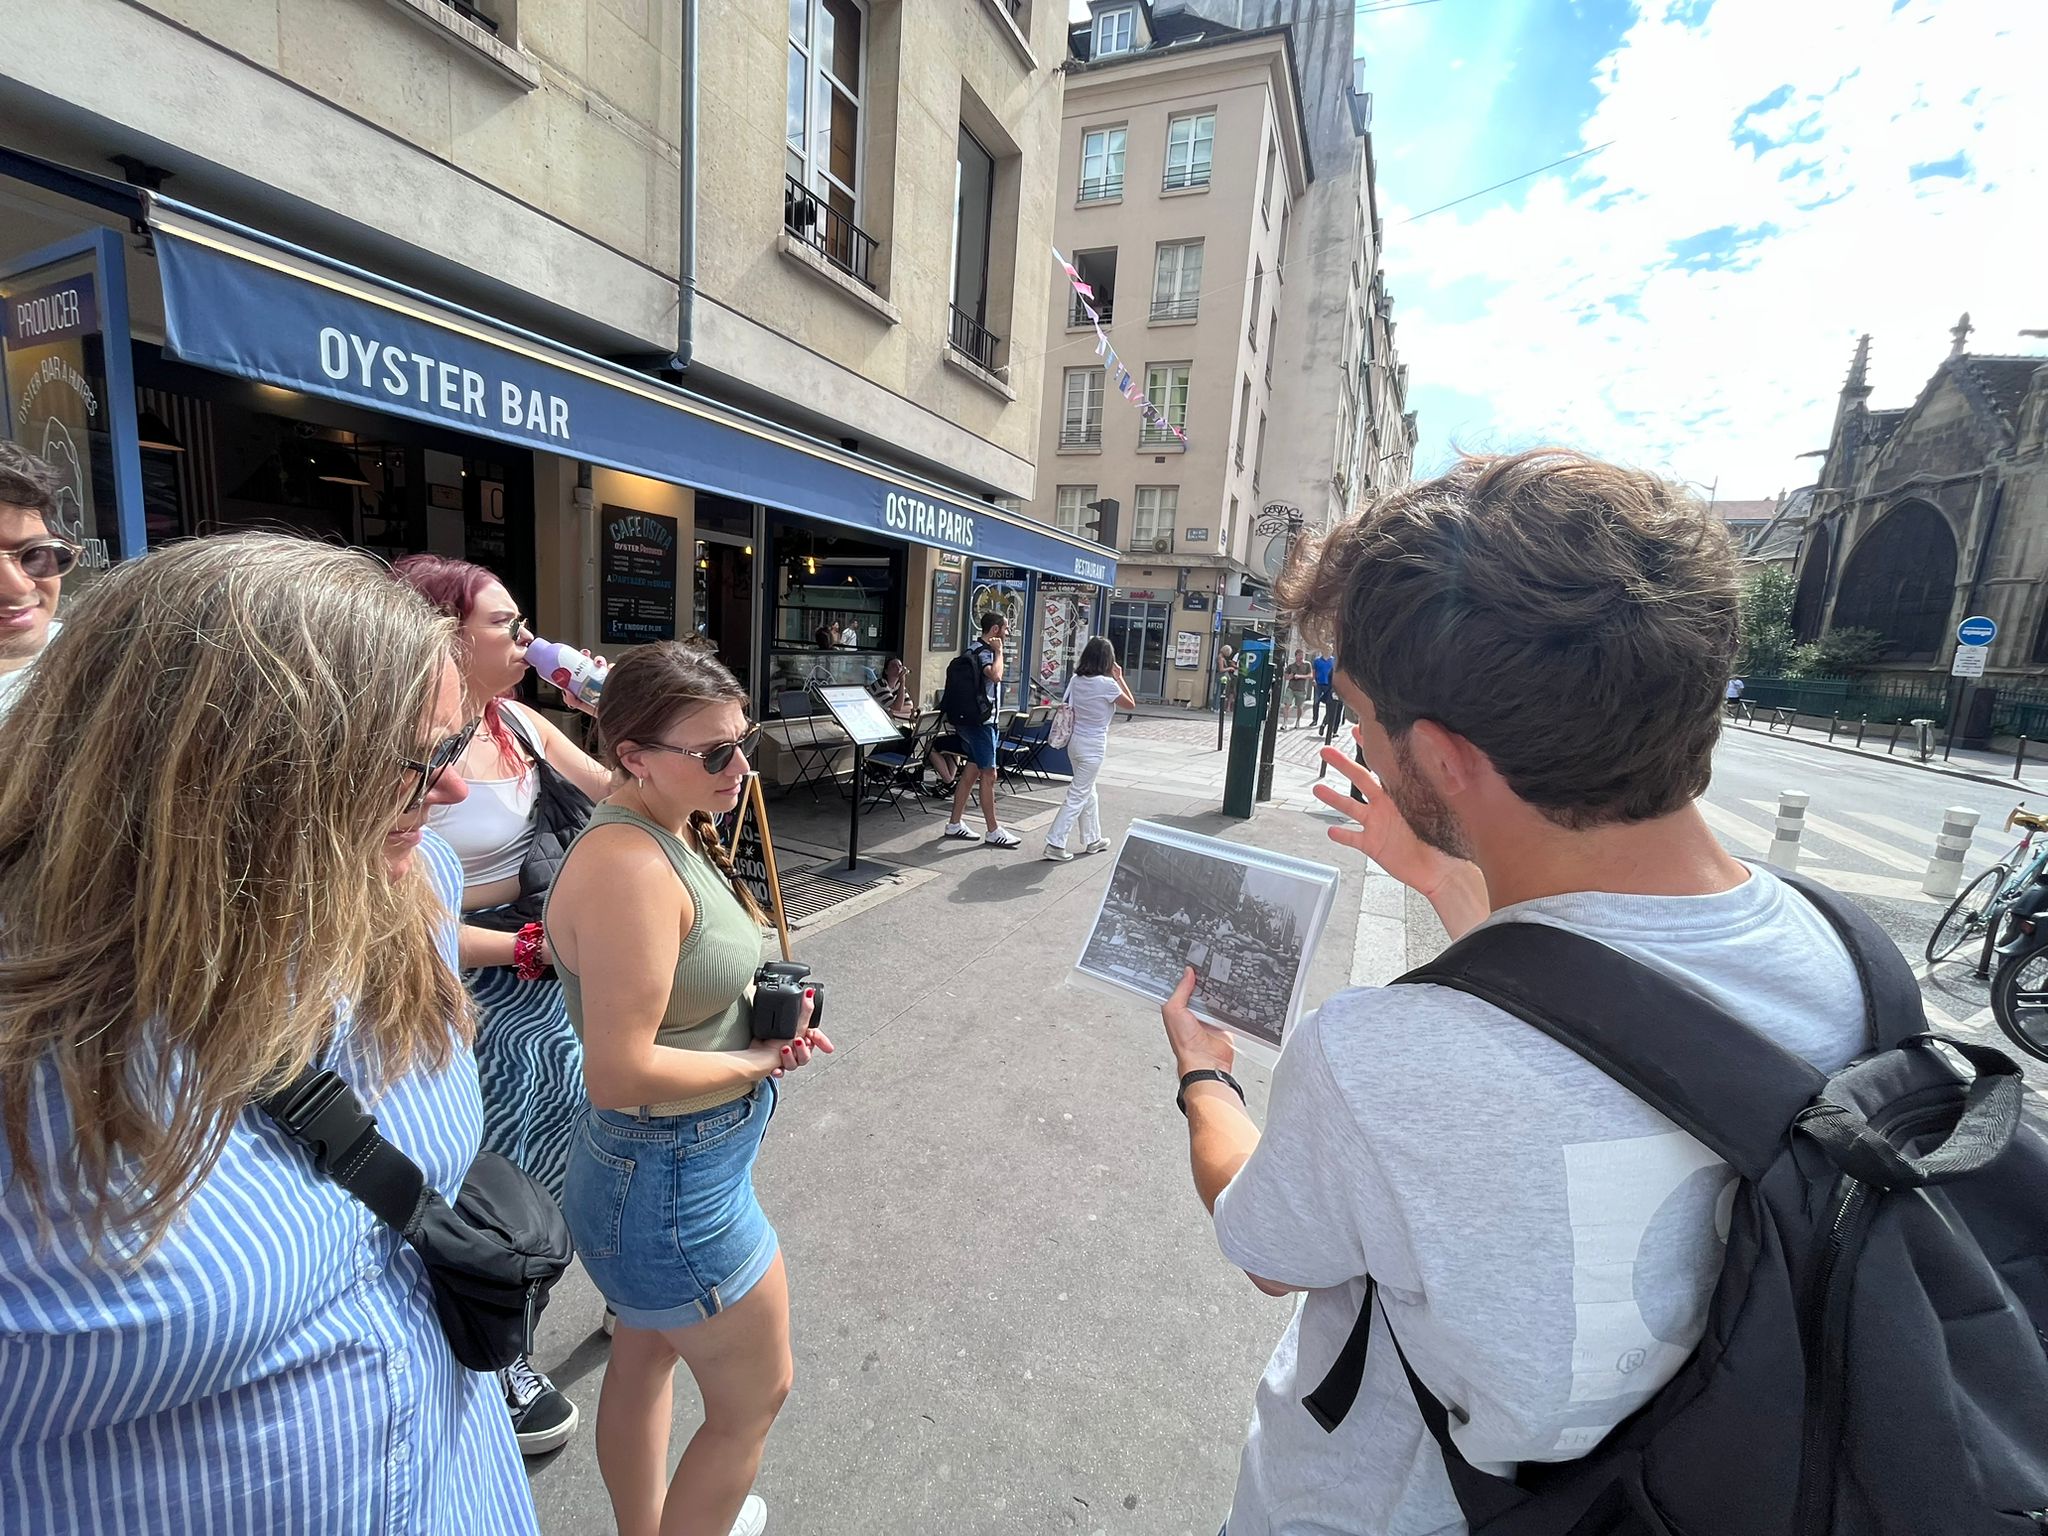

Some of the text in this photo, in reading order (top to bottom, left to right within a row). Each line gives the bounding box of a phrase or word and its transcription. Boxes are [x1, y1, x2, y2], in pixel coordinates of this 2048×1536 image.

[17, 289, 80, 338] PRODUCER
[18, 372, 42, 425] OYSTER
[41, 356, 61, 383] BAR
[320, 327, 570, 440] OYSTER BAR
[886, 492, 974, 547] OSTRA PARIS
[614, 542, 639, 553] OYSTER
[988, 568, 1015, 578] OYSTER
[1074, 558, 1106, 580] RESTAURANT
[1246, 652, 1257, 669] P
